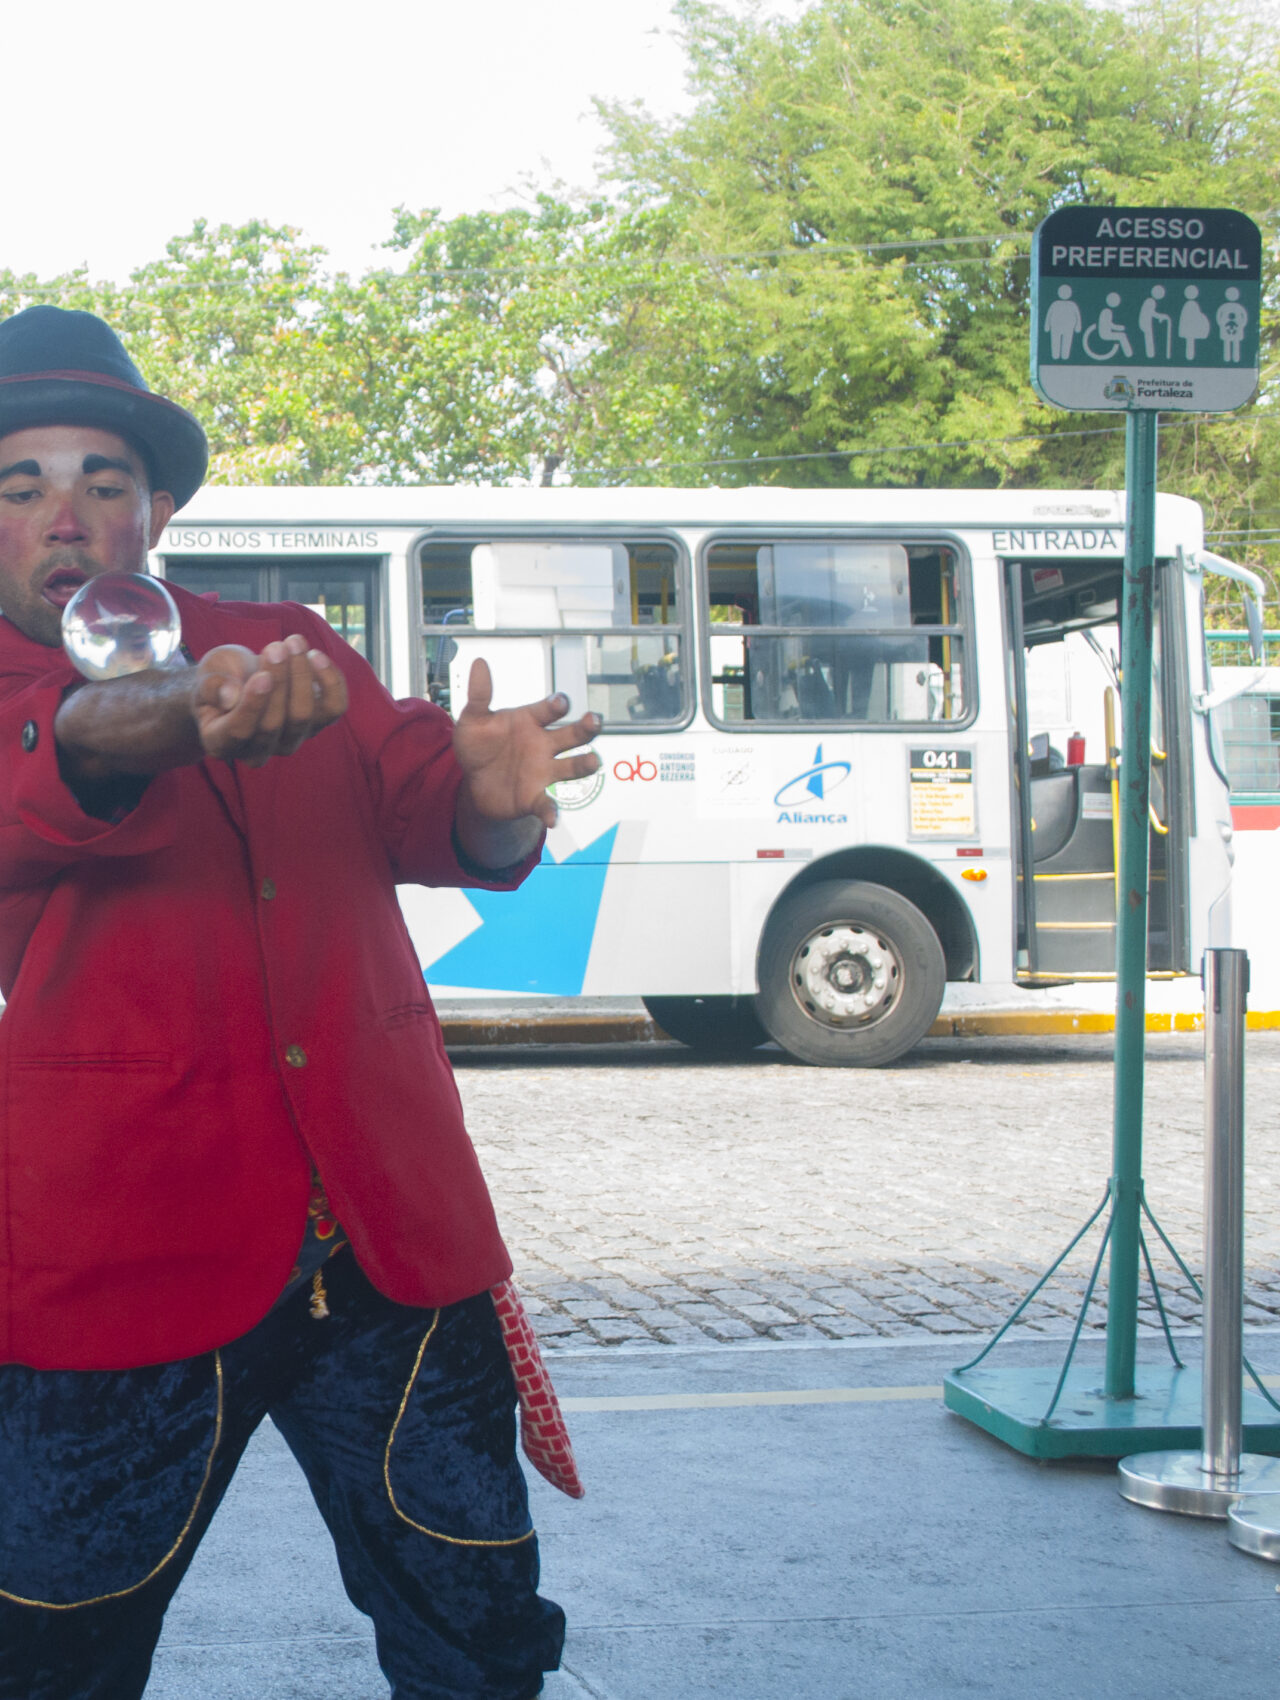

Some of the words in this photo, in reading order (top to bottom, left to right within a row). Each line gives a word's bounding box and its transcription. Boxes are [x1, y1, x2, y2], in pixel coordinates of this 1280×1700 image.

[1096, 218, 1205, 239] ACESSO
[1052, 245, 1249, 269] PREFERENCIAL
[1137, 379, 1180, 387] Prefeitura
[1182, 379, 1193, 387] de
[1137, 387, 1193, 398] Fortaleza
[169, 531, 212, 547] USO
[218, 531, 261, 548] NOS
[267, 531, 378, 548] TERMINAIS
[992, 530, 1117, 551] ENTRADA
[923, 750, 957, 769] 041
[776, 811, 848, 824] Aliança
